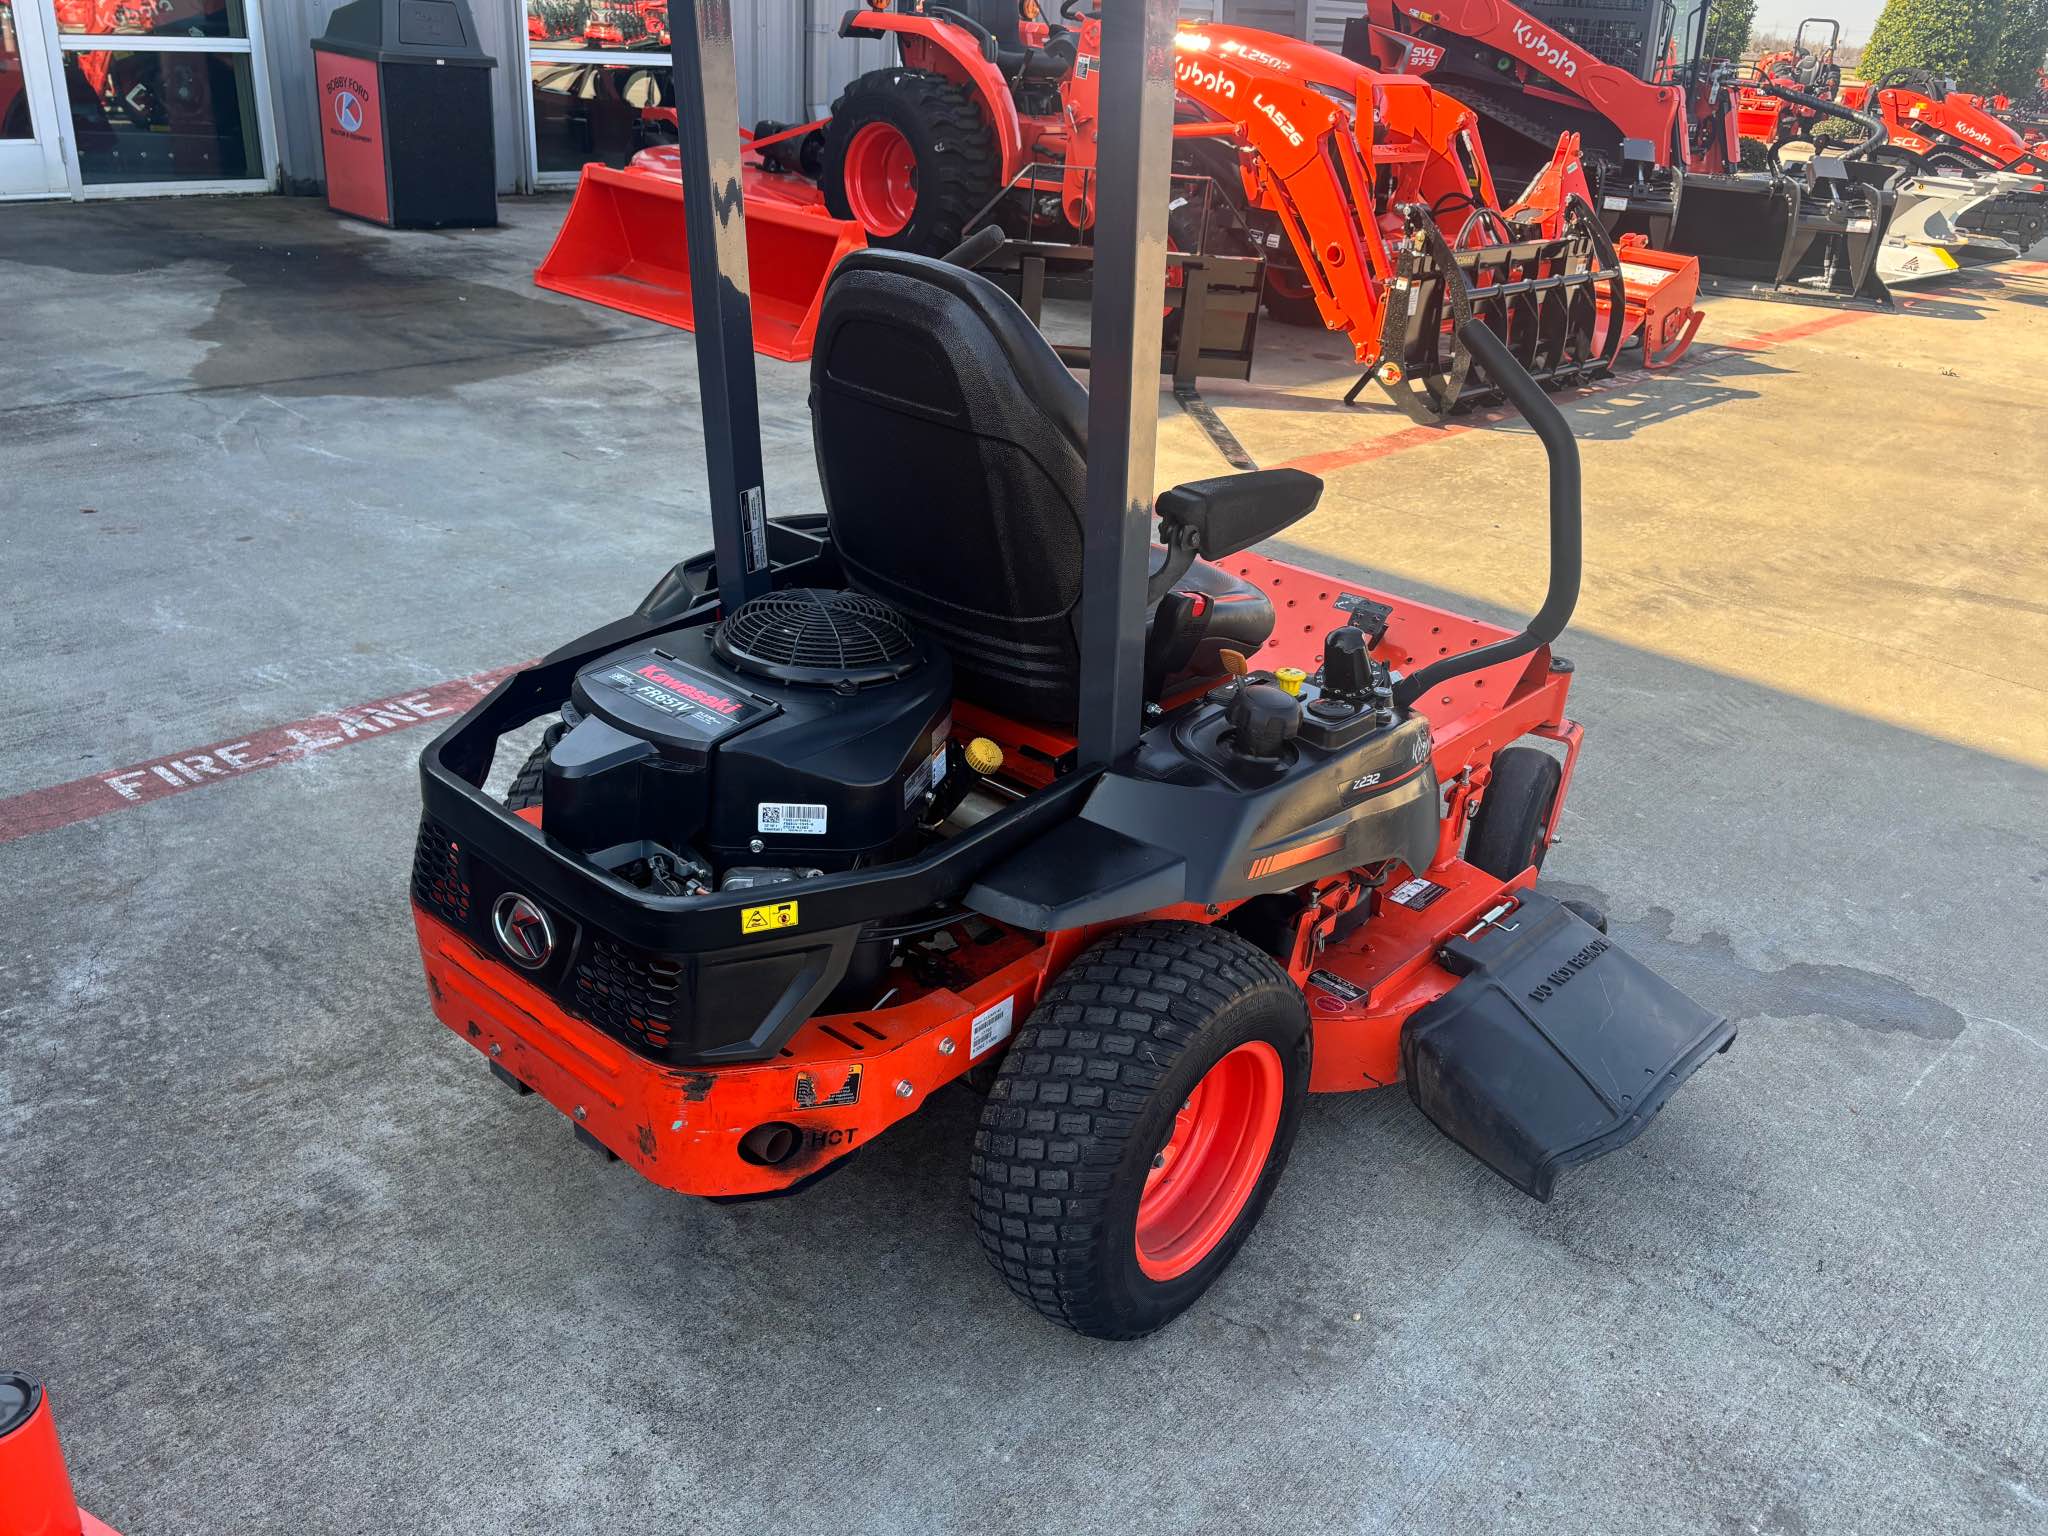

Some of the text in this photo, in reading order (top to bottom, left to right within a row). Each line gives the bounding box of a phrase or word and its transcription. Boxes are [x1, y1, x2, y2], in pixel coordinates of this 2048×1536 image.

[1237, 45, 1292, 71] L2502
[1410, 47, 1438, 58] SVL
[1512, 19, 1577, 78] Kubota
[1410, 57, 1435, 67] 97-3
[327, 76, 369, 101] BOBBY FORD
[1253, 93, 1305, 147] LA526
[1892, 136, 1921, 148] SCL
[1955, 121, 1992, 146] Kubota
[637, 664, 743, 715] Kawasaki
[637, 685, 695, 711] FR651V
[103, 693, 454, 801] FIRE LANE
[1528, 984, 1553, 1003] DO
[1547, 965, 1575, 987] NOT
